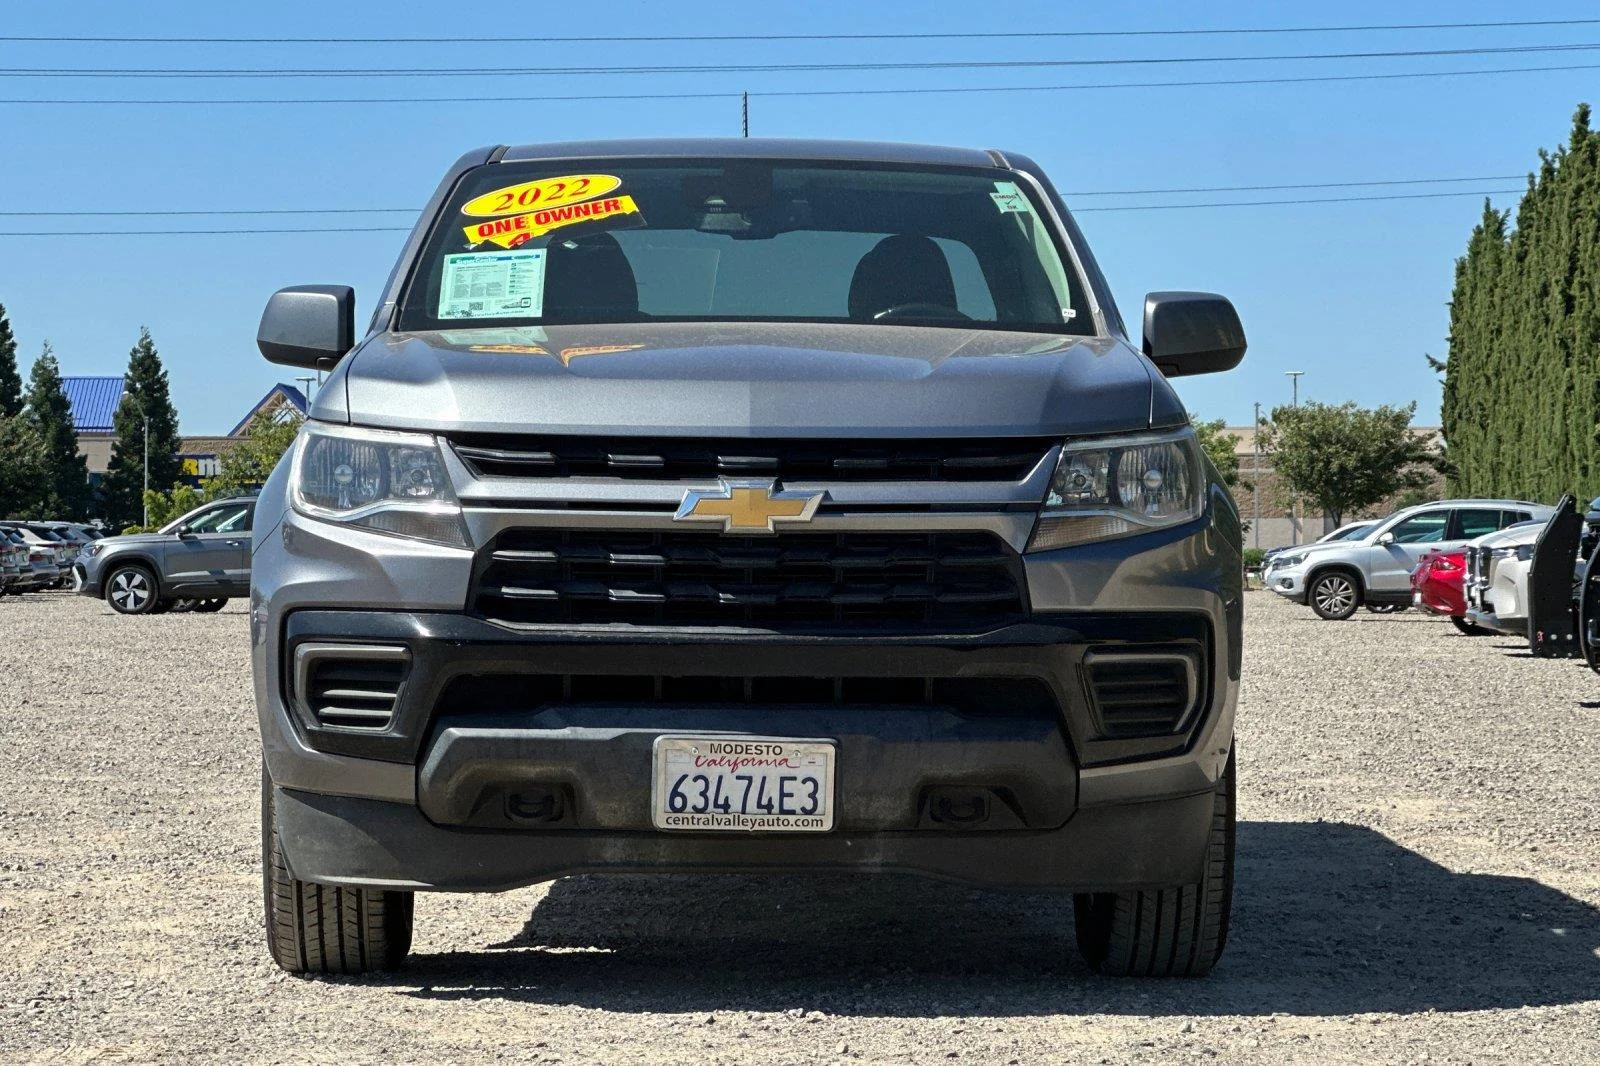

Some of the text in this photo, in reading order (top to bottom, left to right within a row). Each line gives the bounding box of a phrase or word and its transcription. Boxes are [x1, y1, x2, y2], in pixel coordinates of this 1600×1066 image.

[492, 178, 591, 213] 2022
[477, 199, 621, 238] ONE OWNER
[709, 743, 783, 756] MODESTO
[694, 755, 800, 773] California
[668, 773, 820, 815] 63474E3
[665, 814, 824, 831] centralvalleyauto.com
